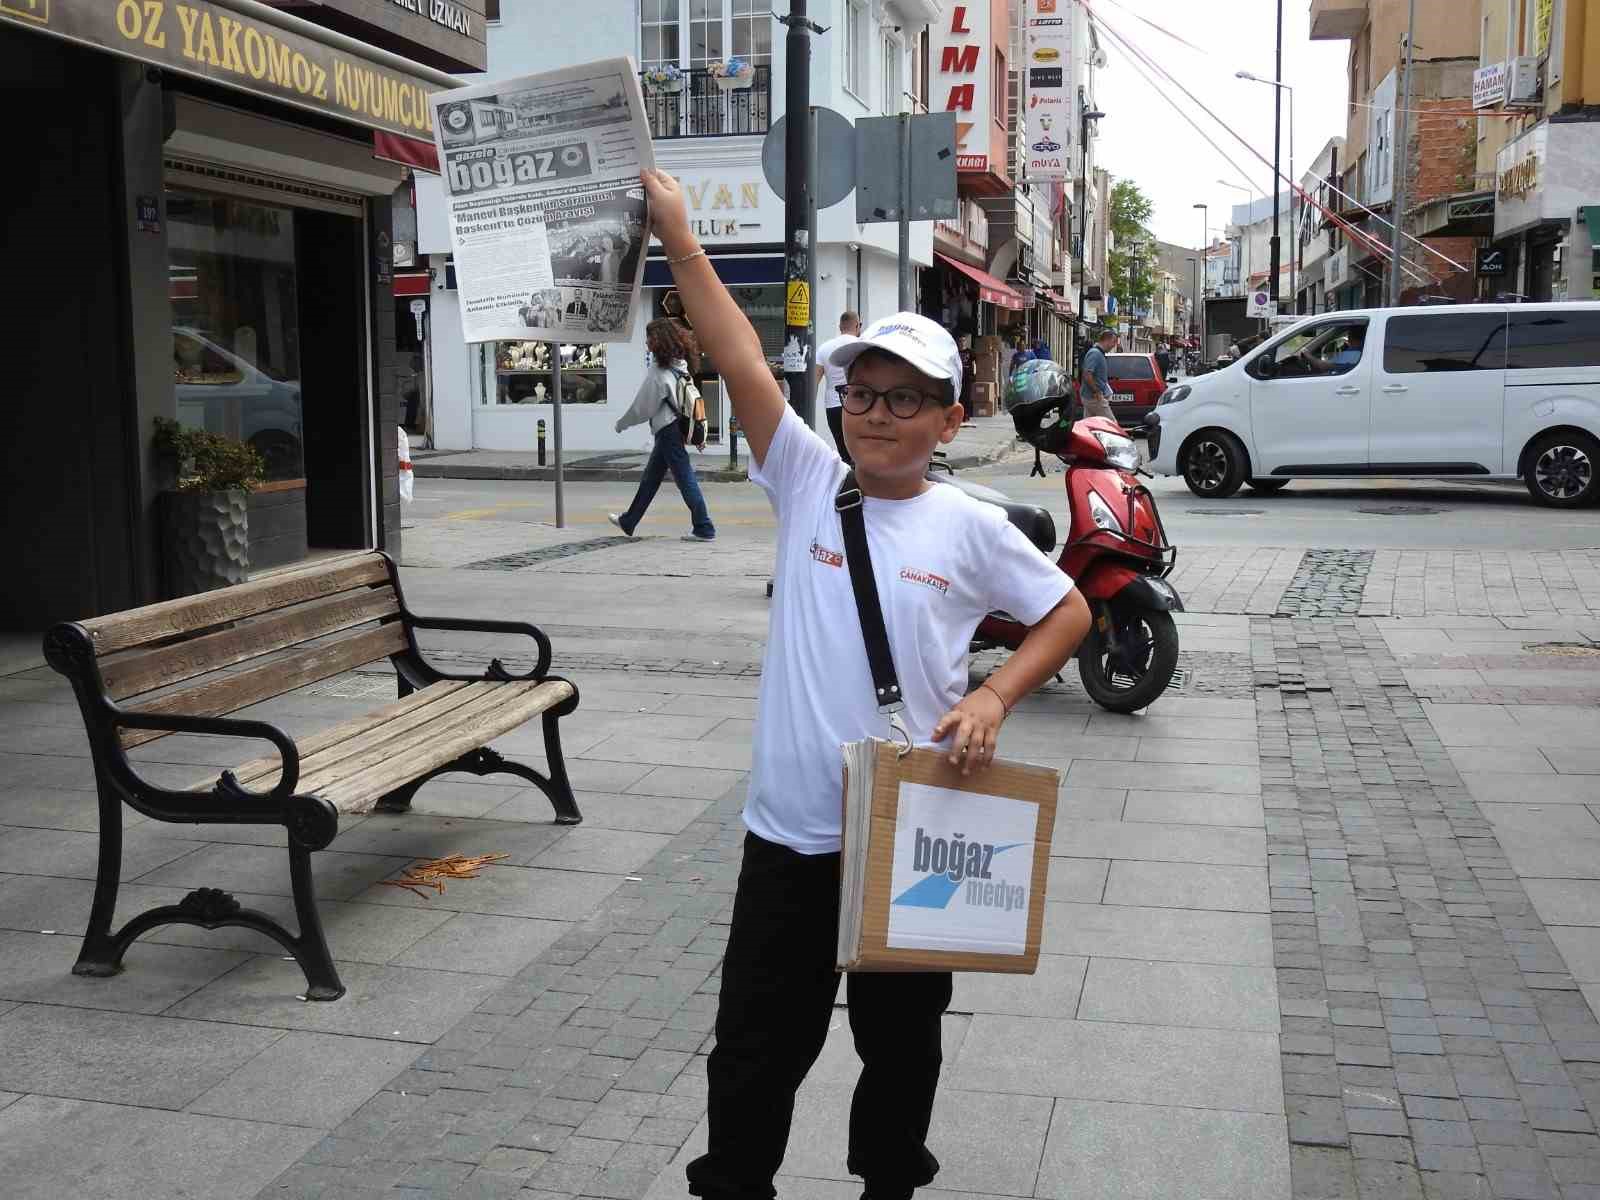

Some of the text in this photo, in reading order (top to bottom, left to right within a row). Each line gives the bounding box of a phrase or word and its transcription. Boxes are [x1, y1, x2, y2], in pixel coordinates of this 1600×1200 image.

[1474, 73, 1504, 94] HAMAM
[447, 151, 557, 193] boğaz
[674, 176, 761, 210] VAN
[913, 827, 995, 881] boğaz
[965, 878, 1025, 912] medya
